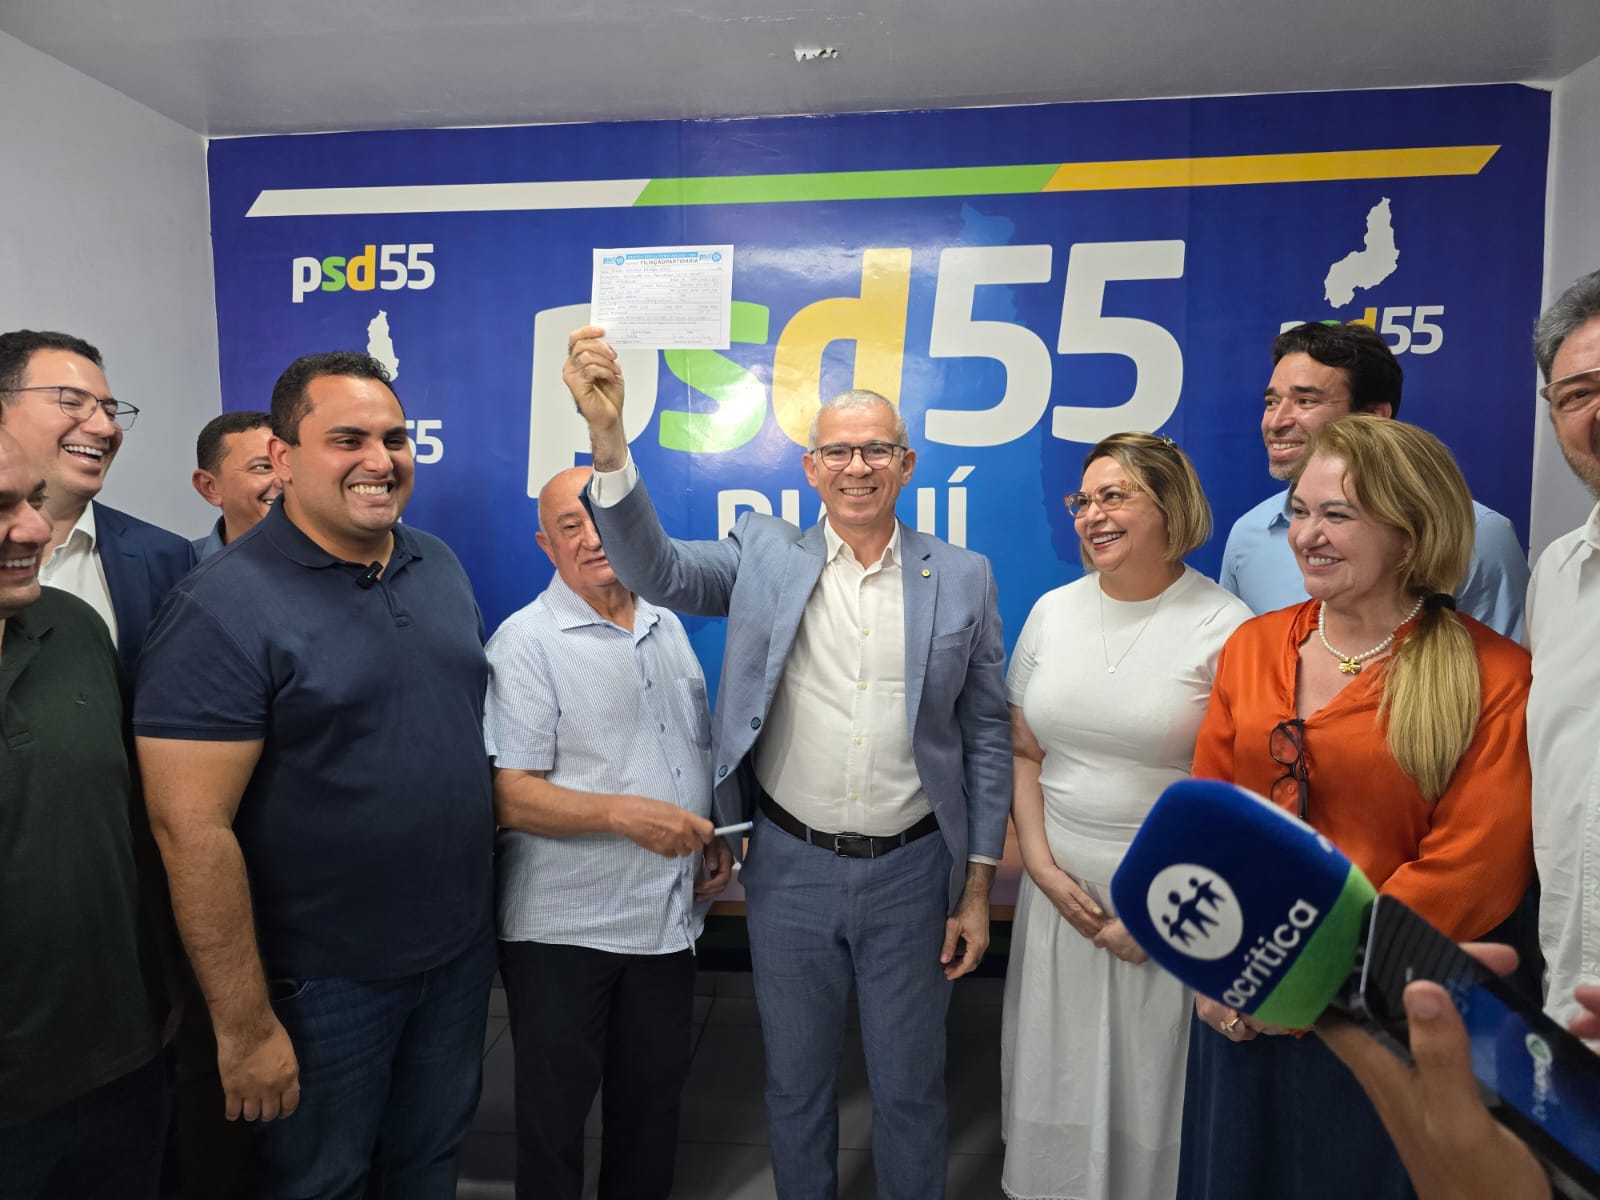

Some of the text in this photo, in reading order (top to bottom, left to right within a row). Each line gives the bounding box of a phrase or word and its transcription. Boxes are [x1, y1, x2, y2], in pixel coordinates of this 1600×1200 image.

[292, 243, 435, 303] psd55
[528, 239, 1185, 500] psd55
[1222, 898, 1320, 1009] acrítica
